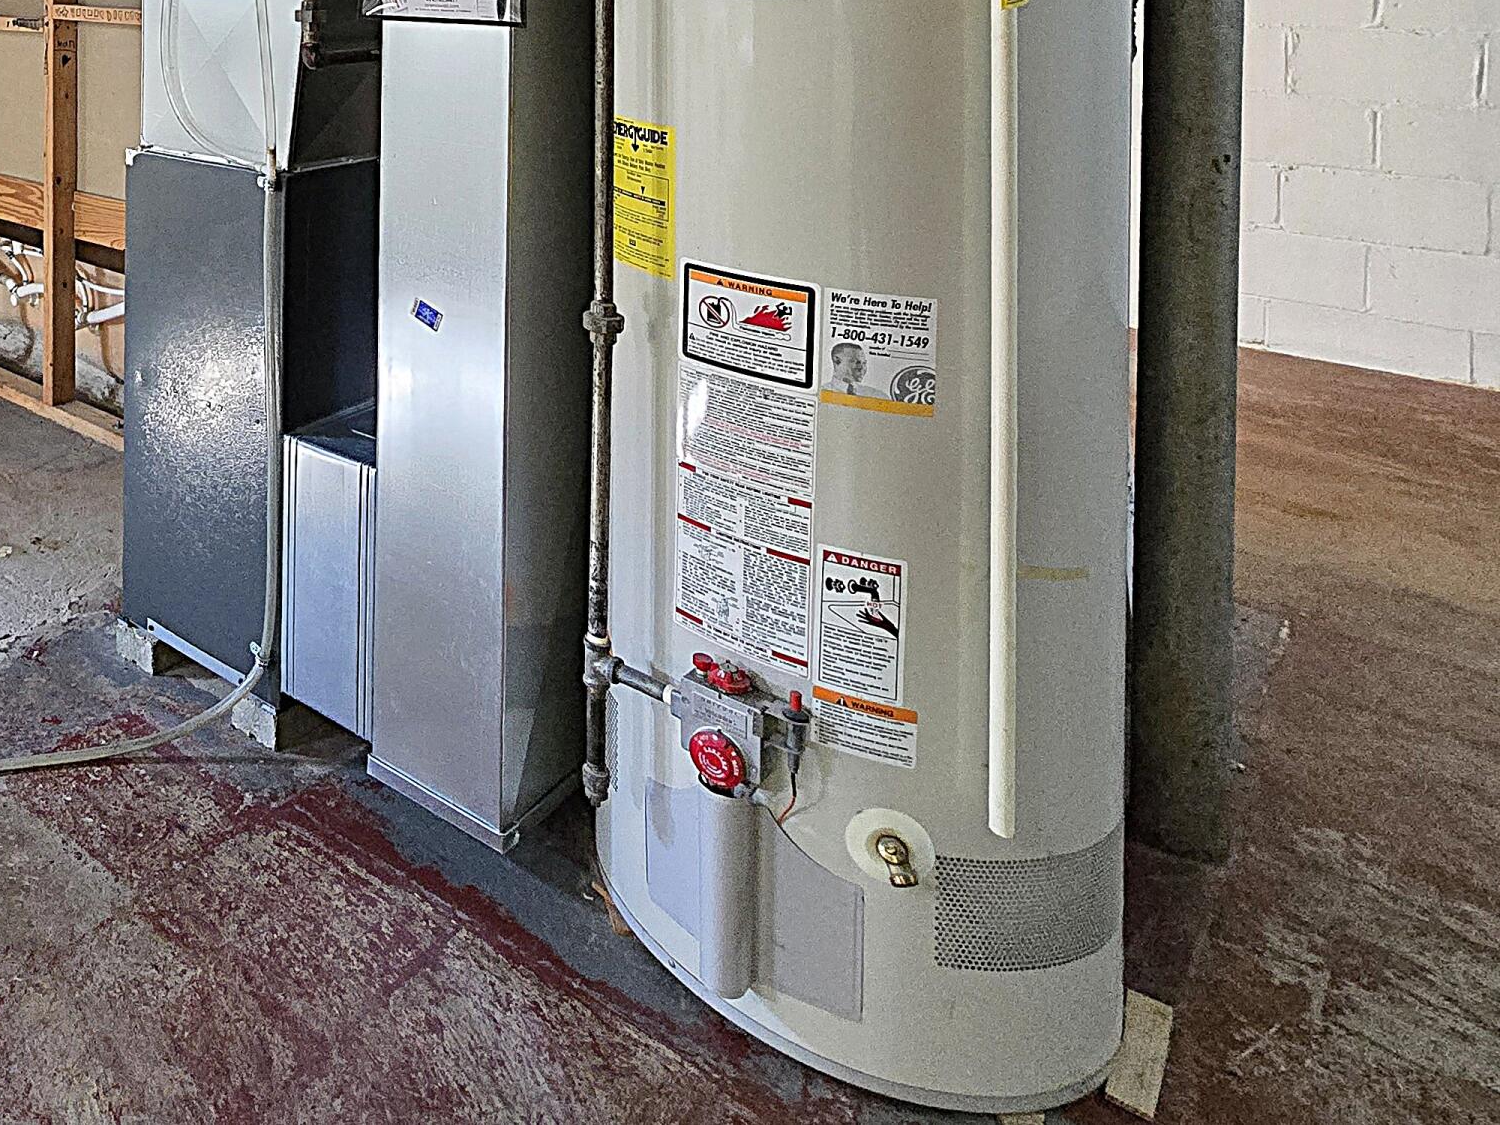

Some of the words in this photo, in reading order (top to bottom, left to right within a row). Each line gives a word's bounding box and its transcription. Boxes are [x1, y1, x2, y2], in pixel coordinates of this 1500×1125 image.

[728, 281, 773, 296] WARNING
[831, 292, 860, 305] We're
[863, 296, 888, 308] Here
[891, 299, 902, 310] To
[905, 300, 933, 315] Help!
[830, 326, 930, 349] 1-800-431-1549
[841, 556, 897, 575] DANGER
[851, 700, 894, 718] WARNING
